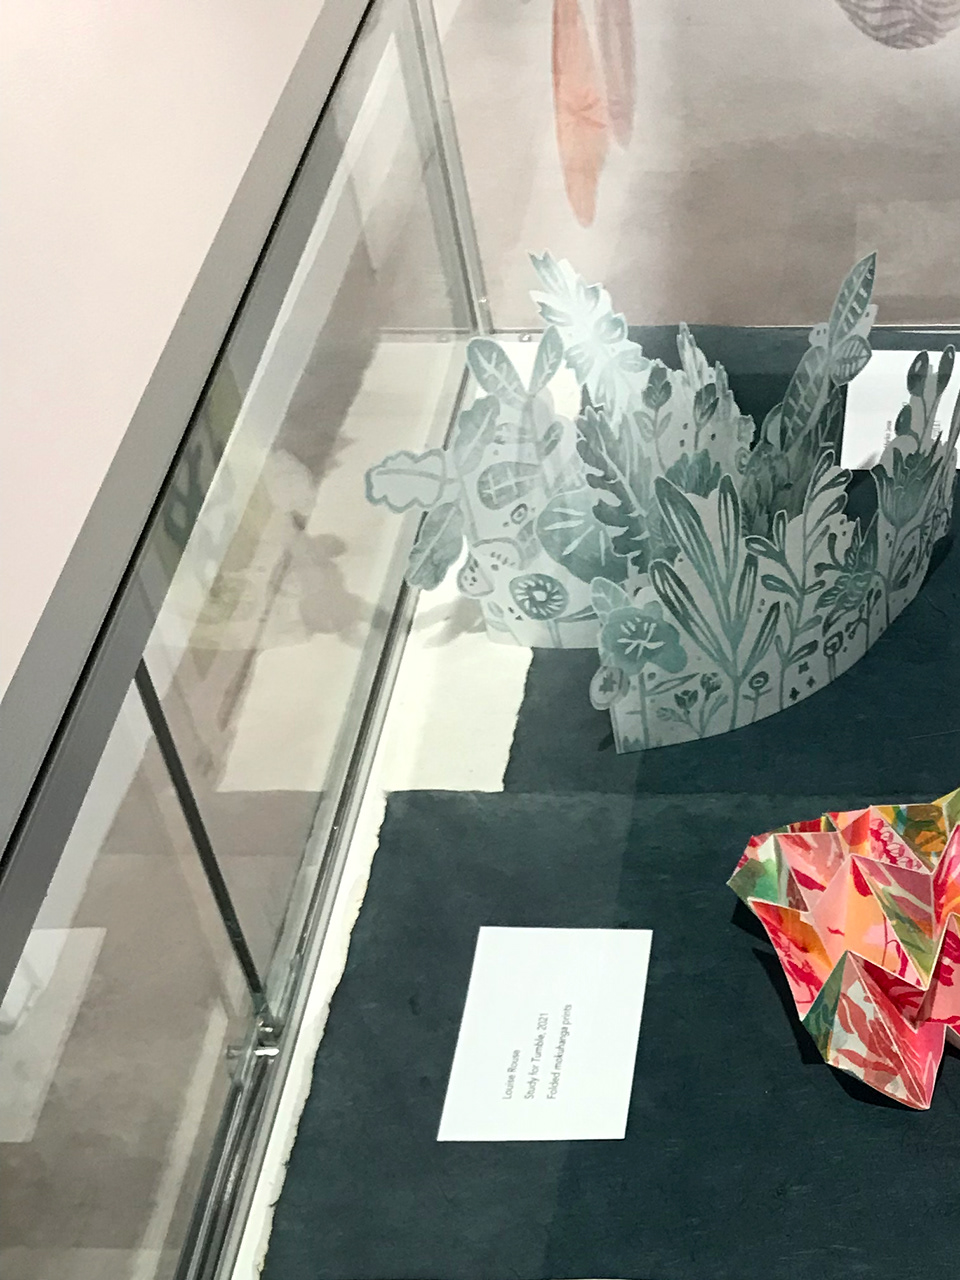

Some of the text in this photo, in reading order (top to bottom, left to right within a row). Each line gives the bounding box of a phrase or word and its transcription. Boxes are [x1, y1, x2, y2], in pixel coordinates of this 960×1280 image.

[502, 1050, 521, 1099] Louise Rouse
[524, 1012, 548, 1099] Study for Tumble, 2021
[547, 1004, 573, 1099] Folded mokuhanga prints
